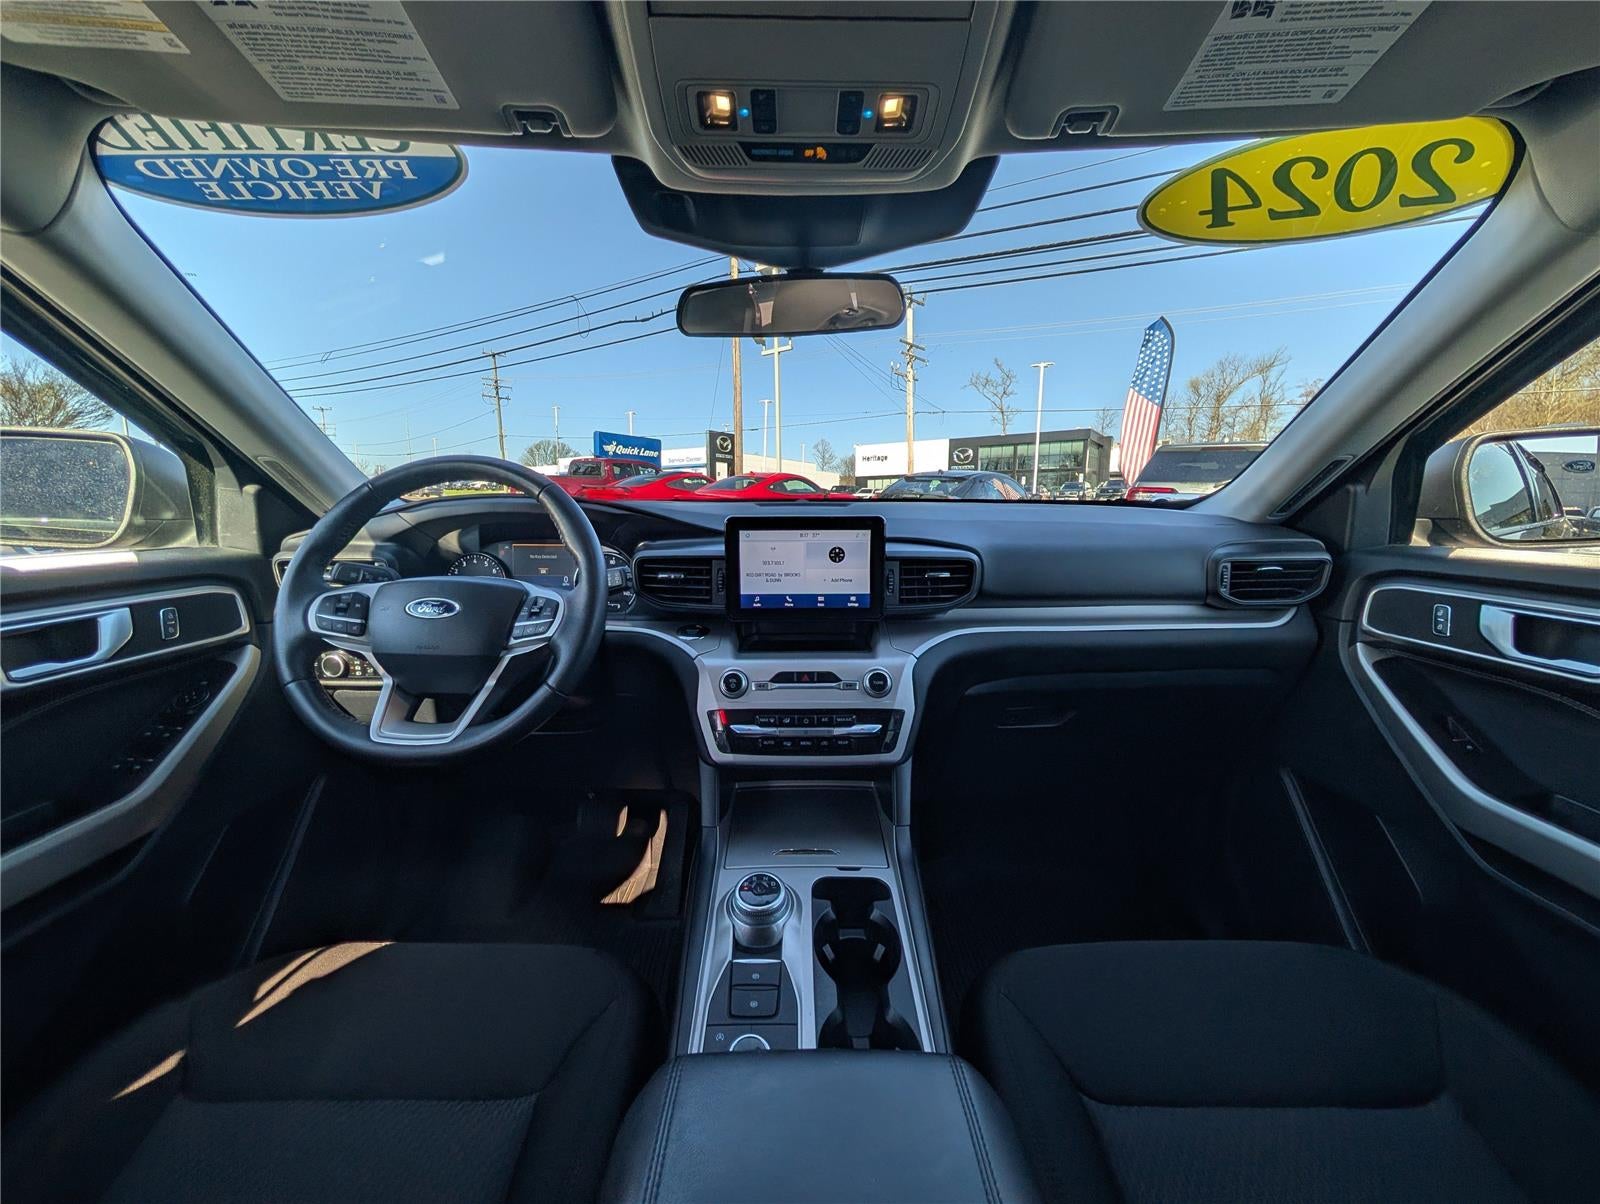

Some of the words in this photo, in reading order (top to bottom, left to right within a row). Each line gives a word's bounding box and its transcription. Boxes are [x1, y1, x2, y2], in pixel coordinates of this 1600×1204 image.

[616, 445, 639, 456] Quick
[640, 447, 659, 458] Lane
[862, 454, 888, 463] Heritage
